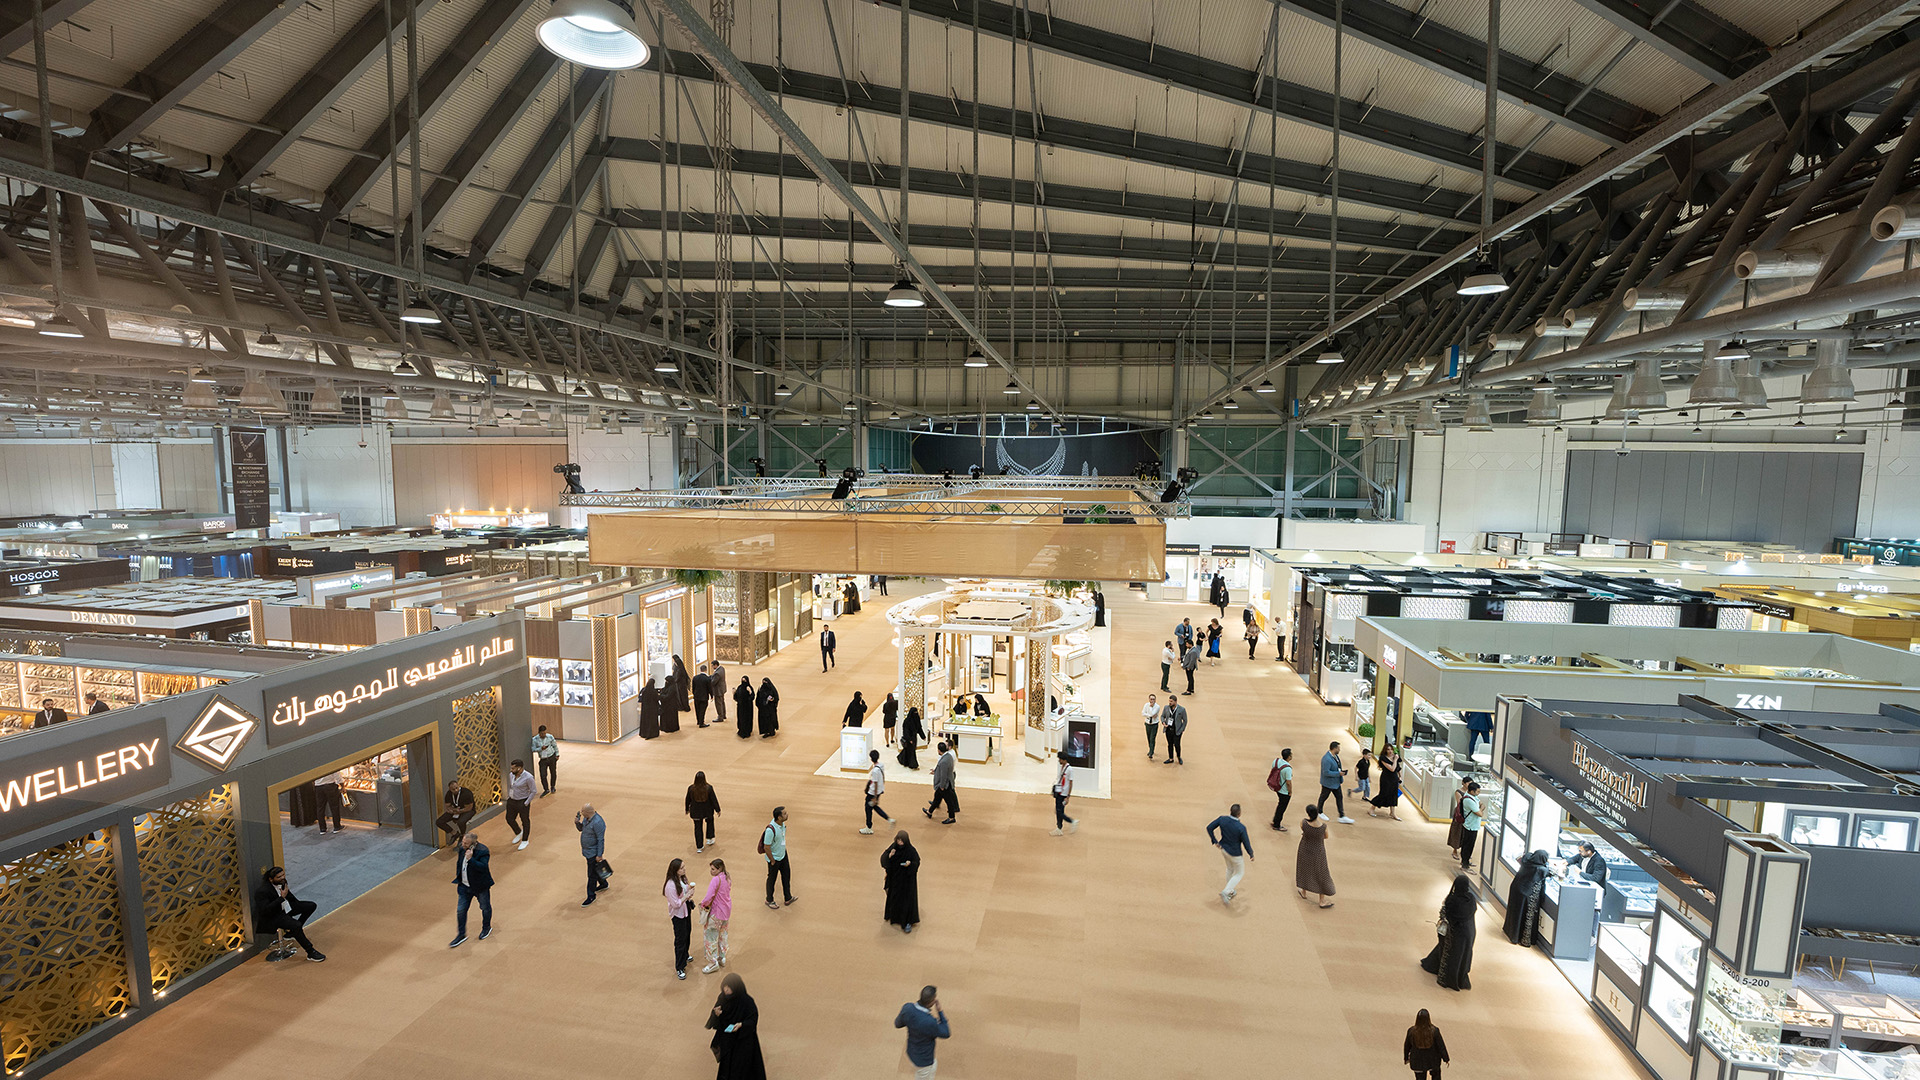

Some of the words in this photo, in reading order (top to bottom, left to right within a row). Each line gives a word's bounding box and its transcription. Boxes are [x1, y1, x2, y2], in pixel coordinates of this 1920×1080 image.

[71, 611, 136, 625] DEMANTO
[480, 637, 514, 666] سالم
[272, 668, 399, 726] للمجوهرات
[1734, 694, 1782, 710] ZEN
[1580, 769, 1586, 778] BY
[1586, 774, 1610, 794] SANDEEP
[1612, 791, 1637, 812] NARANG
[1590, 786, 1608, 802] SINCE
[1584, 790, 1595, 803] NEW
[1595, 798, 1611, 816] DELHI,
[1612, 810, 1627, 826] INDIA
[1721, 962, 1740, 982] 5-200
[1742, 978, 1770, 987] 5-200
